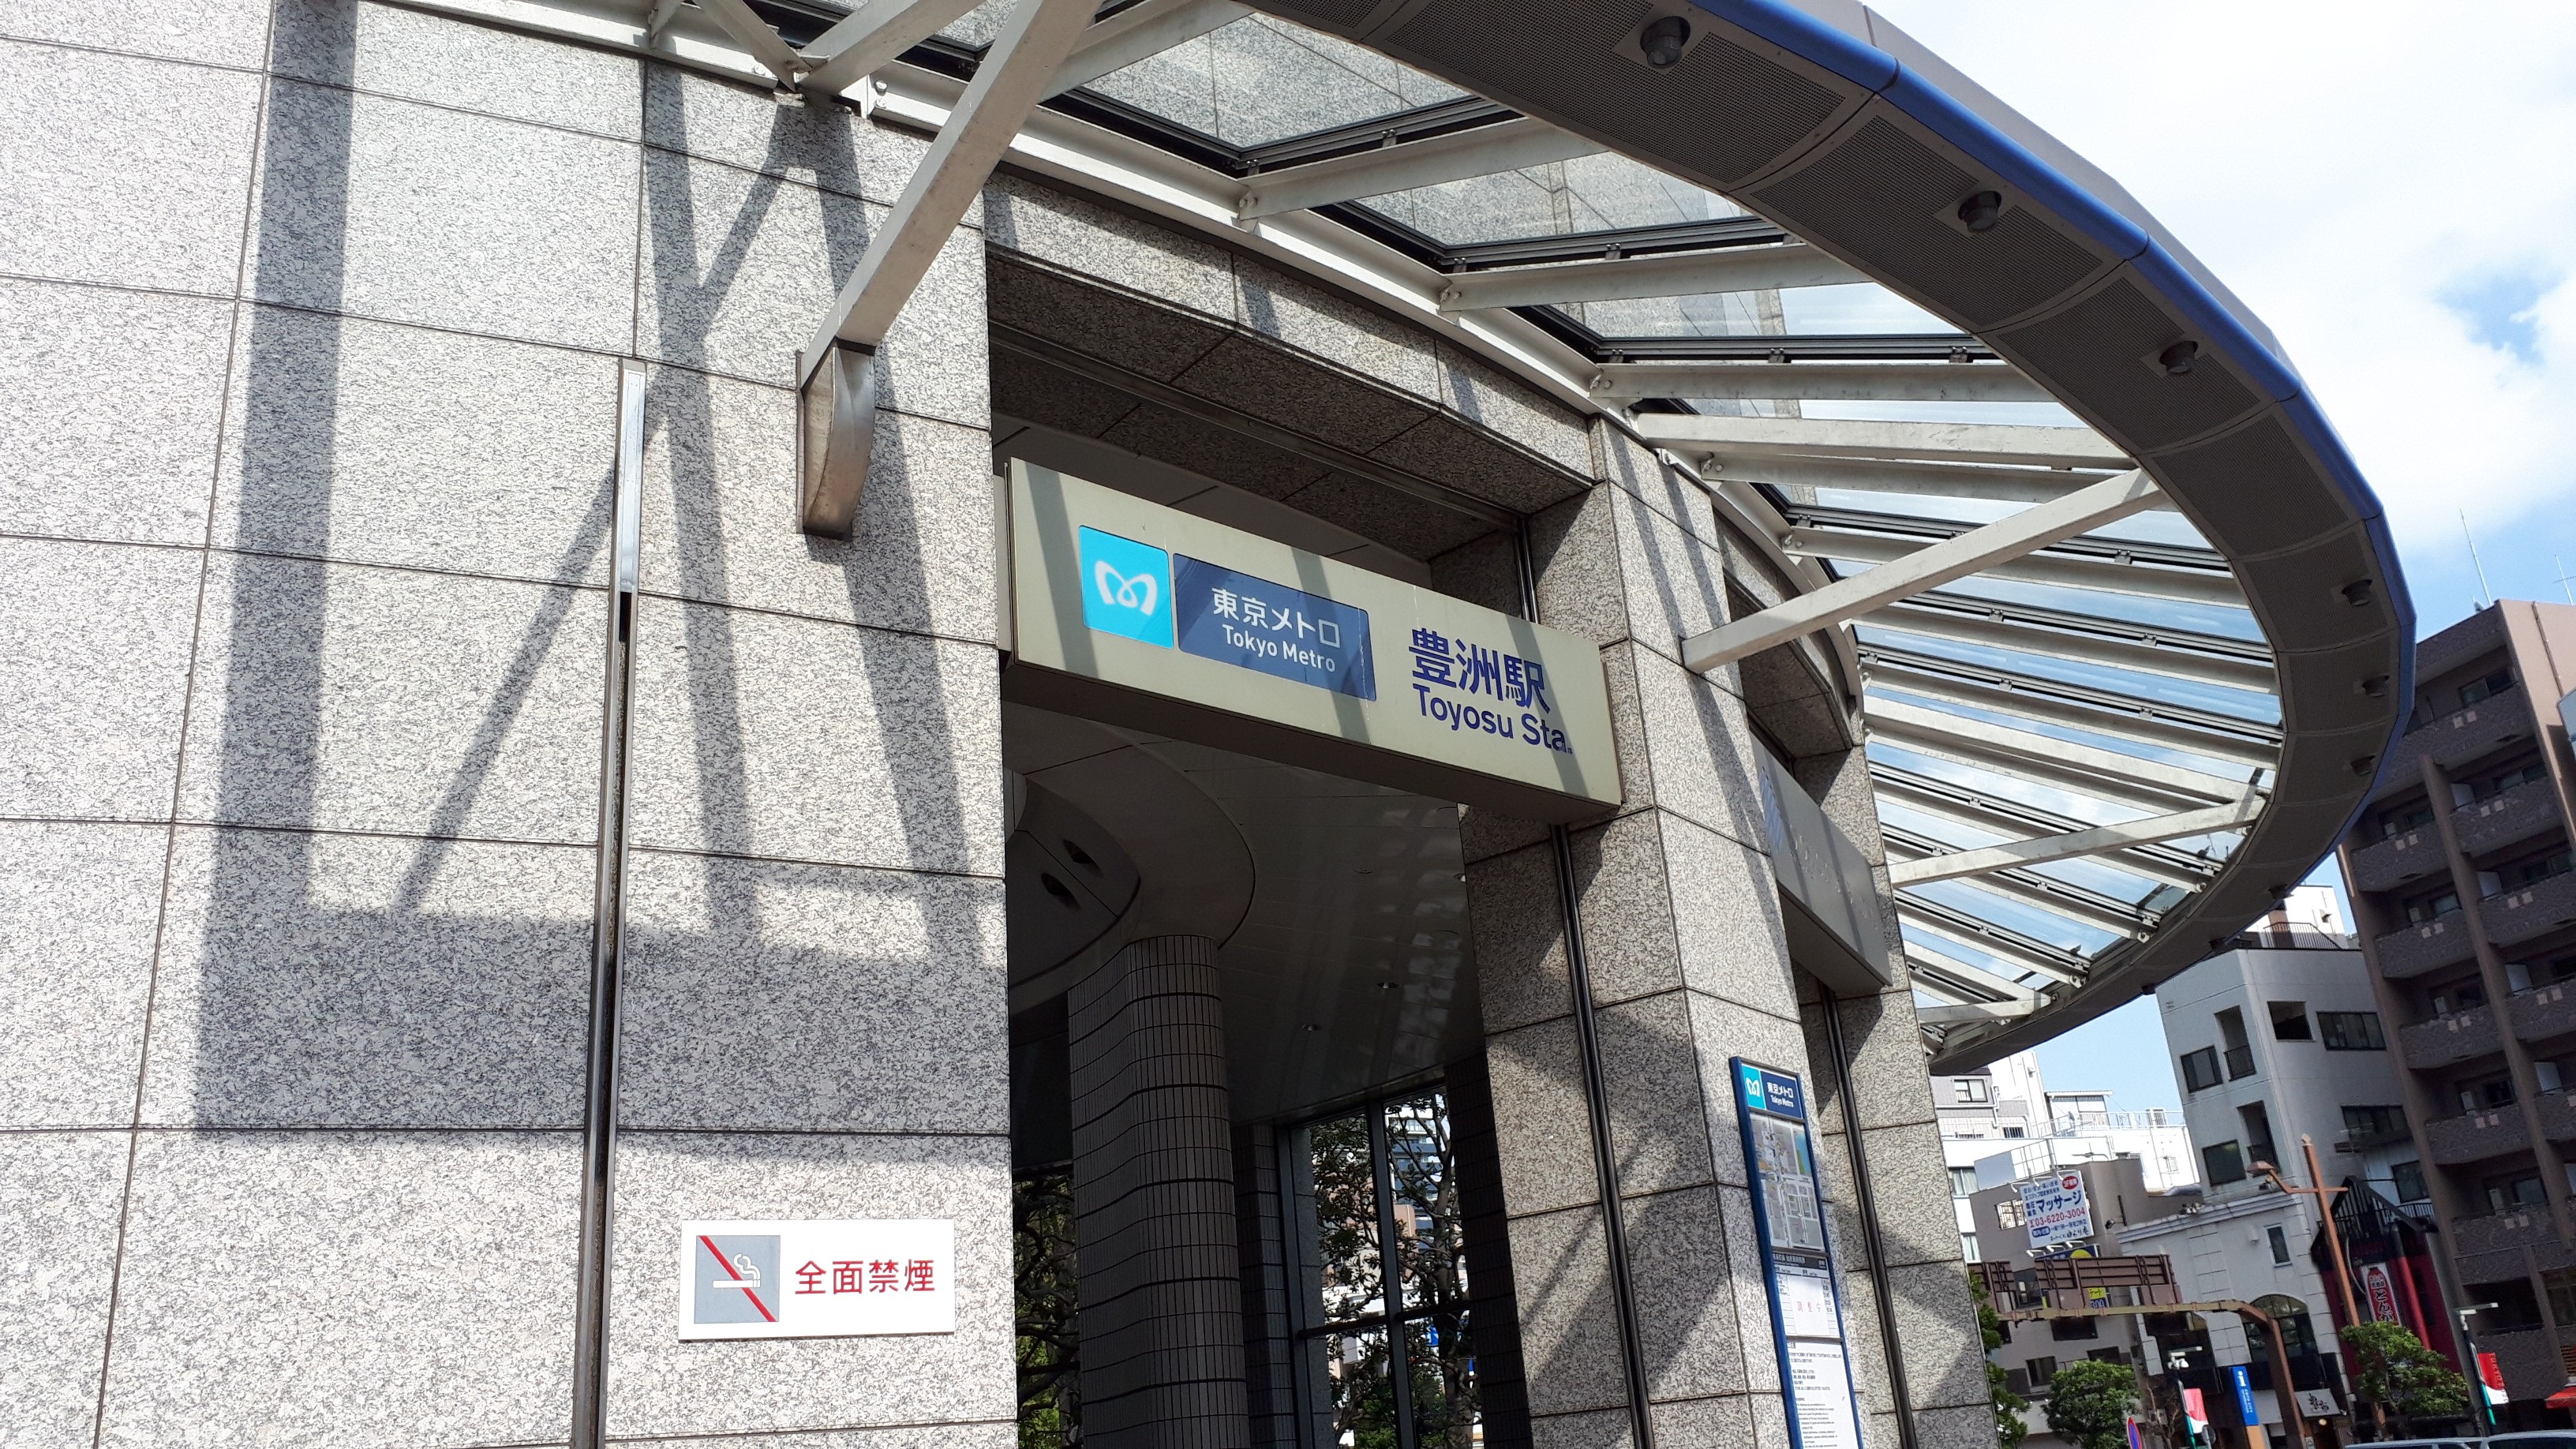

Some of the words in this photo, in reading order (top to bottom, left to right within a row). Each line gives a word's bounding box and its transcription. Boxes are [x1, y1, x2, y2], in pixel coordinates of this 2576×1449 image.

[1211, 587, 1341, 649] 東京メトロ
[1222, 623, 1279, 658] Tokyo
[1282, 640, 1336, 672] Metro
[1408, 627, 1551, 714] 豊洲駅
[1412, 683, 1514, 739] Toyosu
[1521, 713, 1573, 754] Sta.
[1766, 1082, 1794, 1099] 東京メトロ
[2035, 1207, 2086, 1226] 03-6220-3004
[2036, 1190, 2081, 1213] マッサージ
[795, 1258, 935, 1294] 全面禁煙
